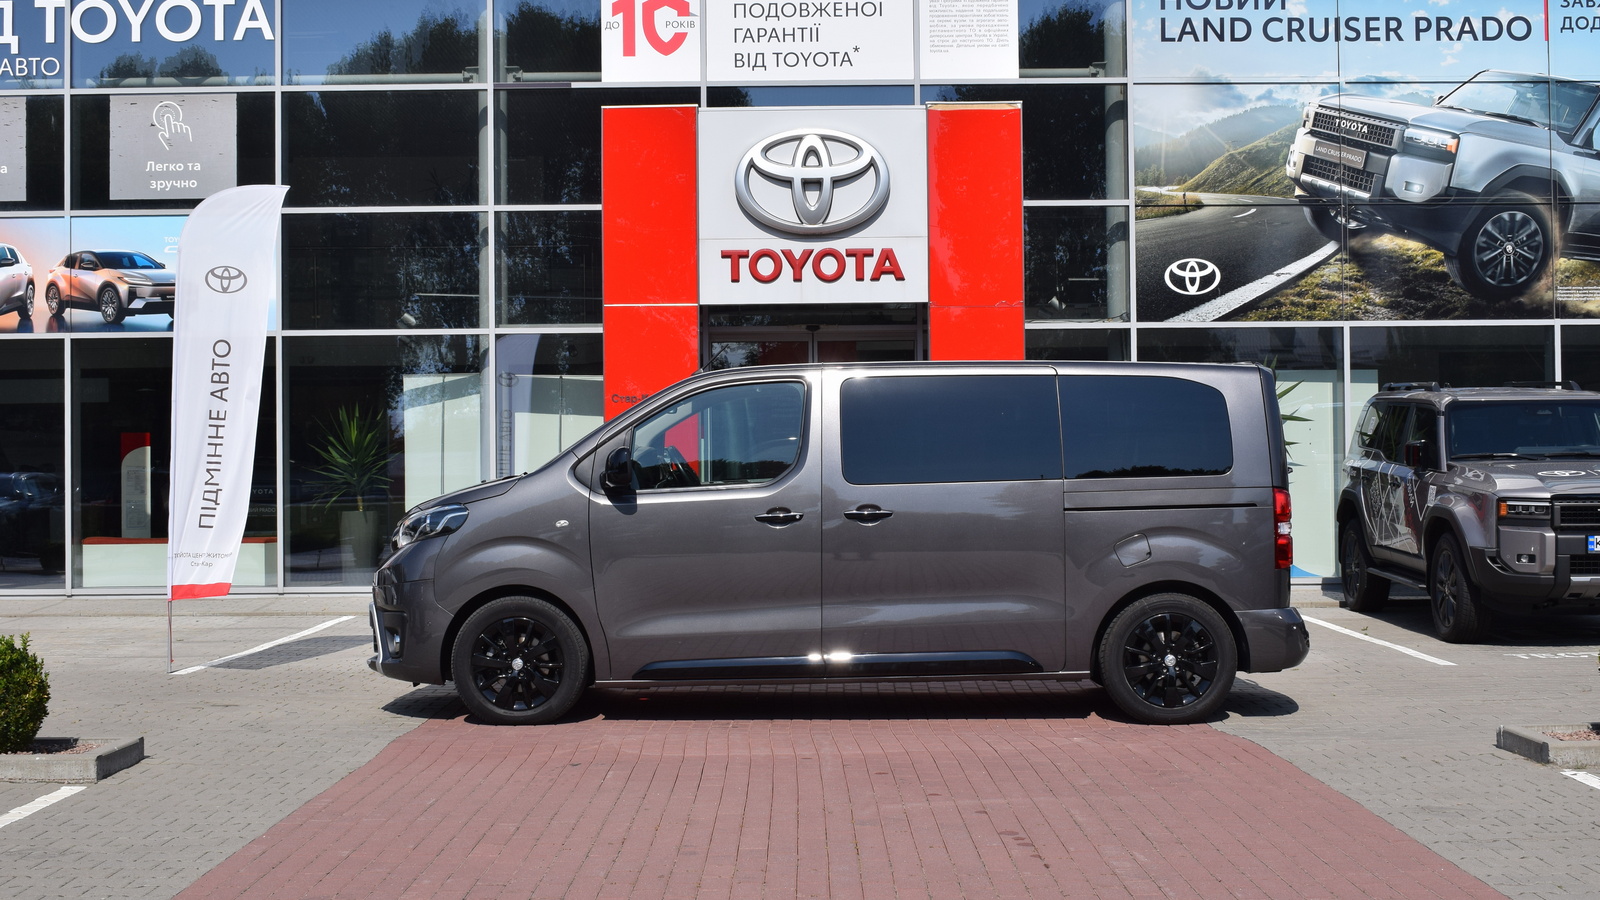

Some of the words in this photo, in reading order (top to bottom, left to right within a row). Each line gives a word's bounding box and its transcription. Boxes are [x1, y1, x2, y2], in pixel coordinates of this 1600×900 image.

[35, 0, 274, 43] TOYOTA
[665, 20, 695, 29] РОКІВ
[1160, 17, 1252, 42] LAND
[1262, 16, 1404, 42] CRUISER
[1415, 16, 1532, 42] PRADO
[734, 23, 821, 43] ГАРАНТІЇ
[0, 57, 60, 76] АВТО
[734, 52, 767, 71] ВІД
[1335, 119, 1368, 133] TOYOTA
[146, 161, 184, 172] Легко
[187, 163, 201, 171] та
[150, 179, 198, 191] зручно
[720, 247, 906, 283] TOYOTA
[210, 339, 232, 403] АВТО
[198, 409, 227, 529] ПІДМІННЕ
